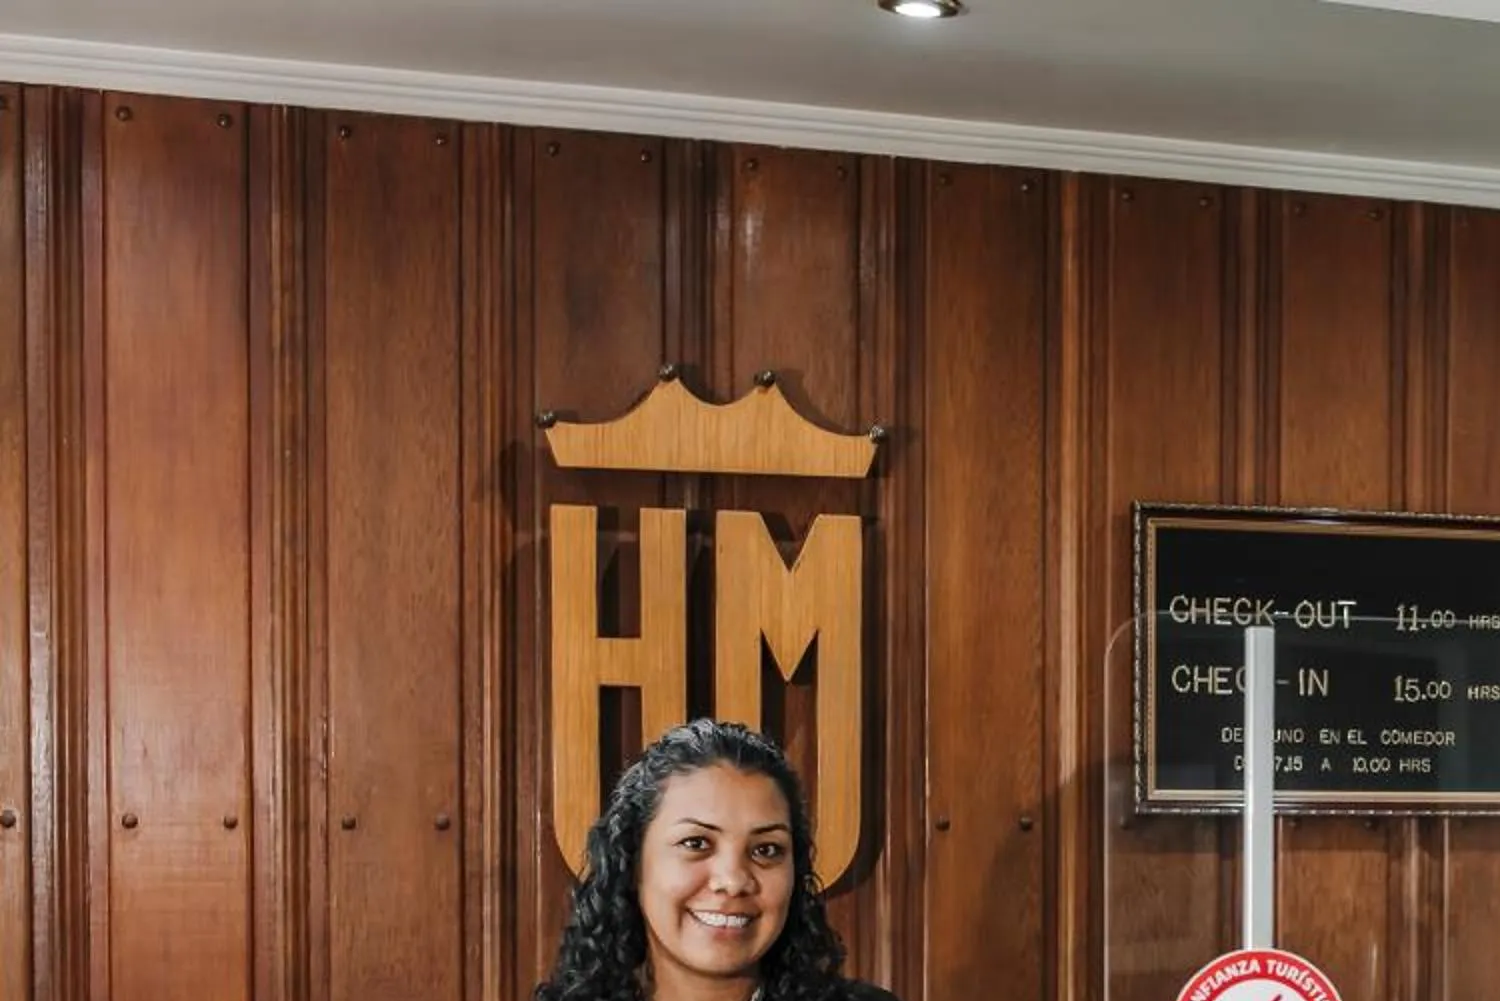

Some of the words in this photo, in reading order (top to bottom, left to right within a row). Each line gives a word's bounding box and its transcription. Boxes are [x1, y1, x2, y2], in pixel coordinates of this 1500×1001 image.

[1169, 594, 1357, 629] CHECK-OUT
[1395, 603, 1456, 632] 11.00
[1394, 674, 1452, 703] 15.00
[1467, 684, 1500, 701] HRS
[1220, 727, 1305, 745] DEUNO
[1319, 728, 1341, 745] EN
[1346, 729, 1368, 746] EL
[1379, 729, 1456, 746] COMEDOR
[1320, 757, 1332, 772] A
[1399, 758, 1432, 774] HRS
